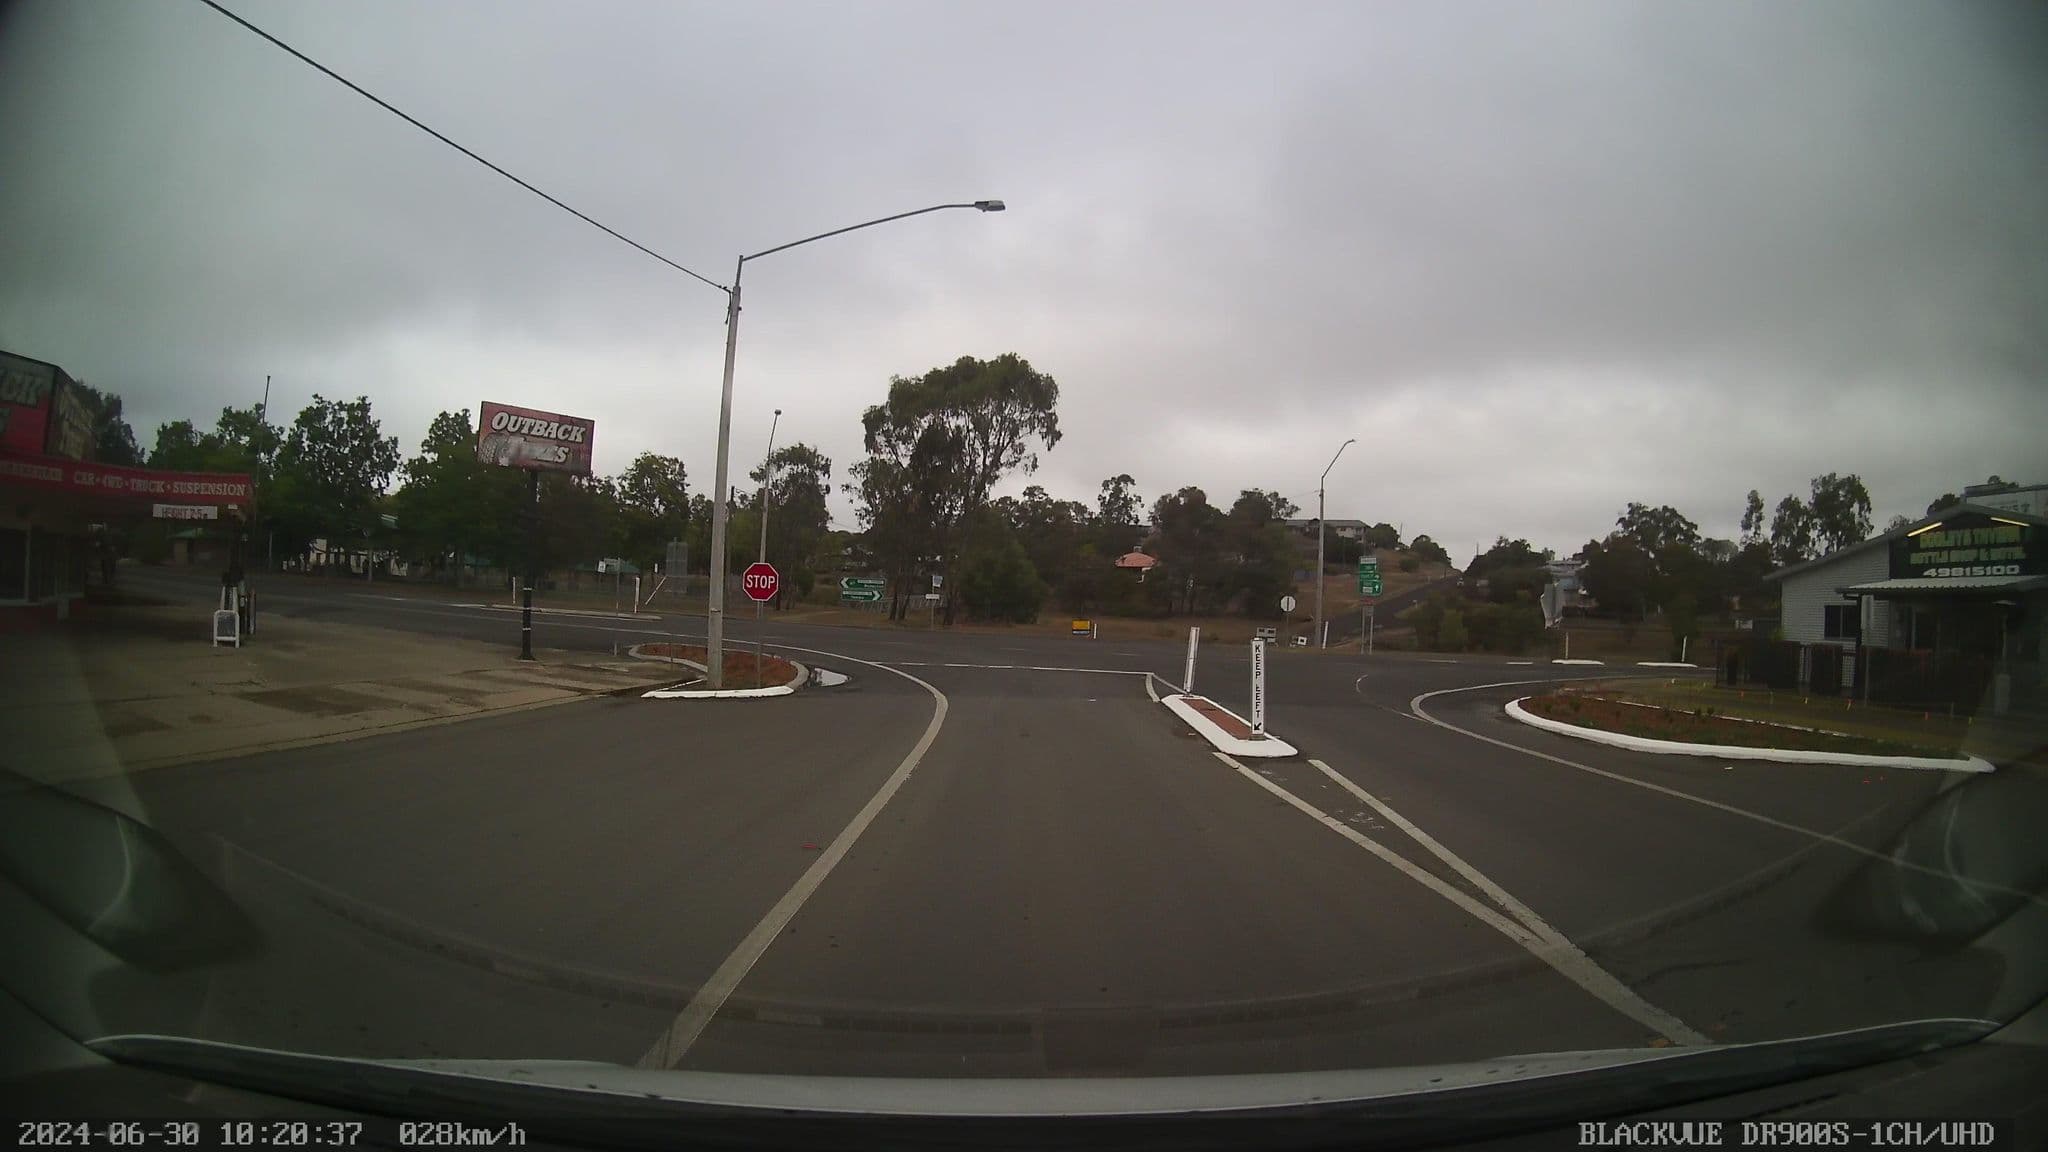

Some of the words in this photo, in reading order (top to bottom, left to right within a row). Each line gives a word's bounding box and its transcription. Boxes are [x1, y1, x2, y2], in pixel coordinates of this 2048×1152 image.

[491, 411, 586, 443] OUTBACK
[73, 471, 96, 485] CAR
[130, 478, 165, 493] TRUCK
[172, 480, 246, 497] SUSPENSION
[1923, 564, 2020, 577] 49815100
[745, 574, 776, 589] STOP
